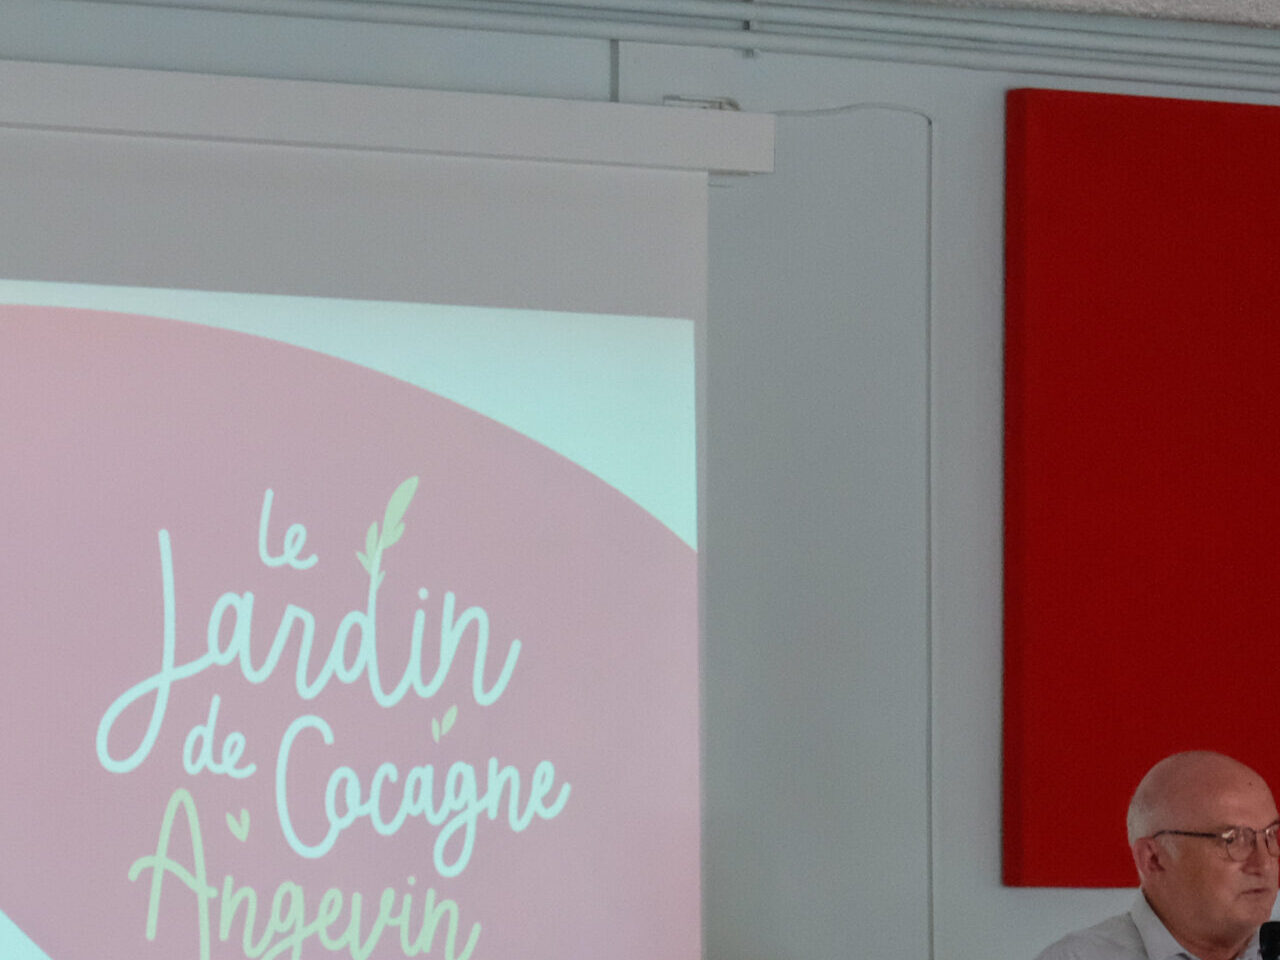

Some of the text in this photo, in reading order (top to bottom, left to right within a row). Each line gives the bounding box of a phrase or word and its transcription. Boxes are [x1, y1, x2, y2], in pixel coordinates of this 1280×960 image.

[96, 529, 522, 773] Jardin
[183, 695, 570, 878] de Cocagne
